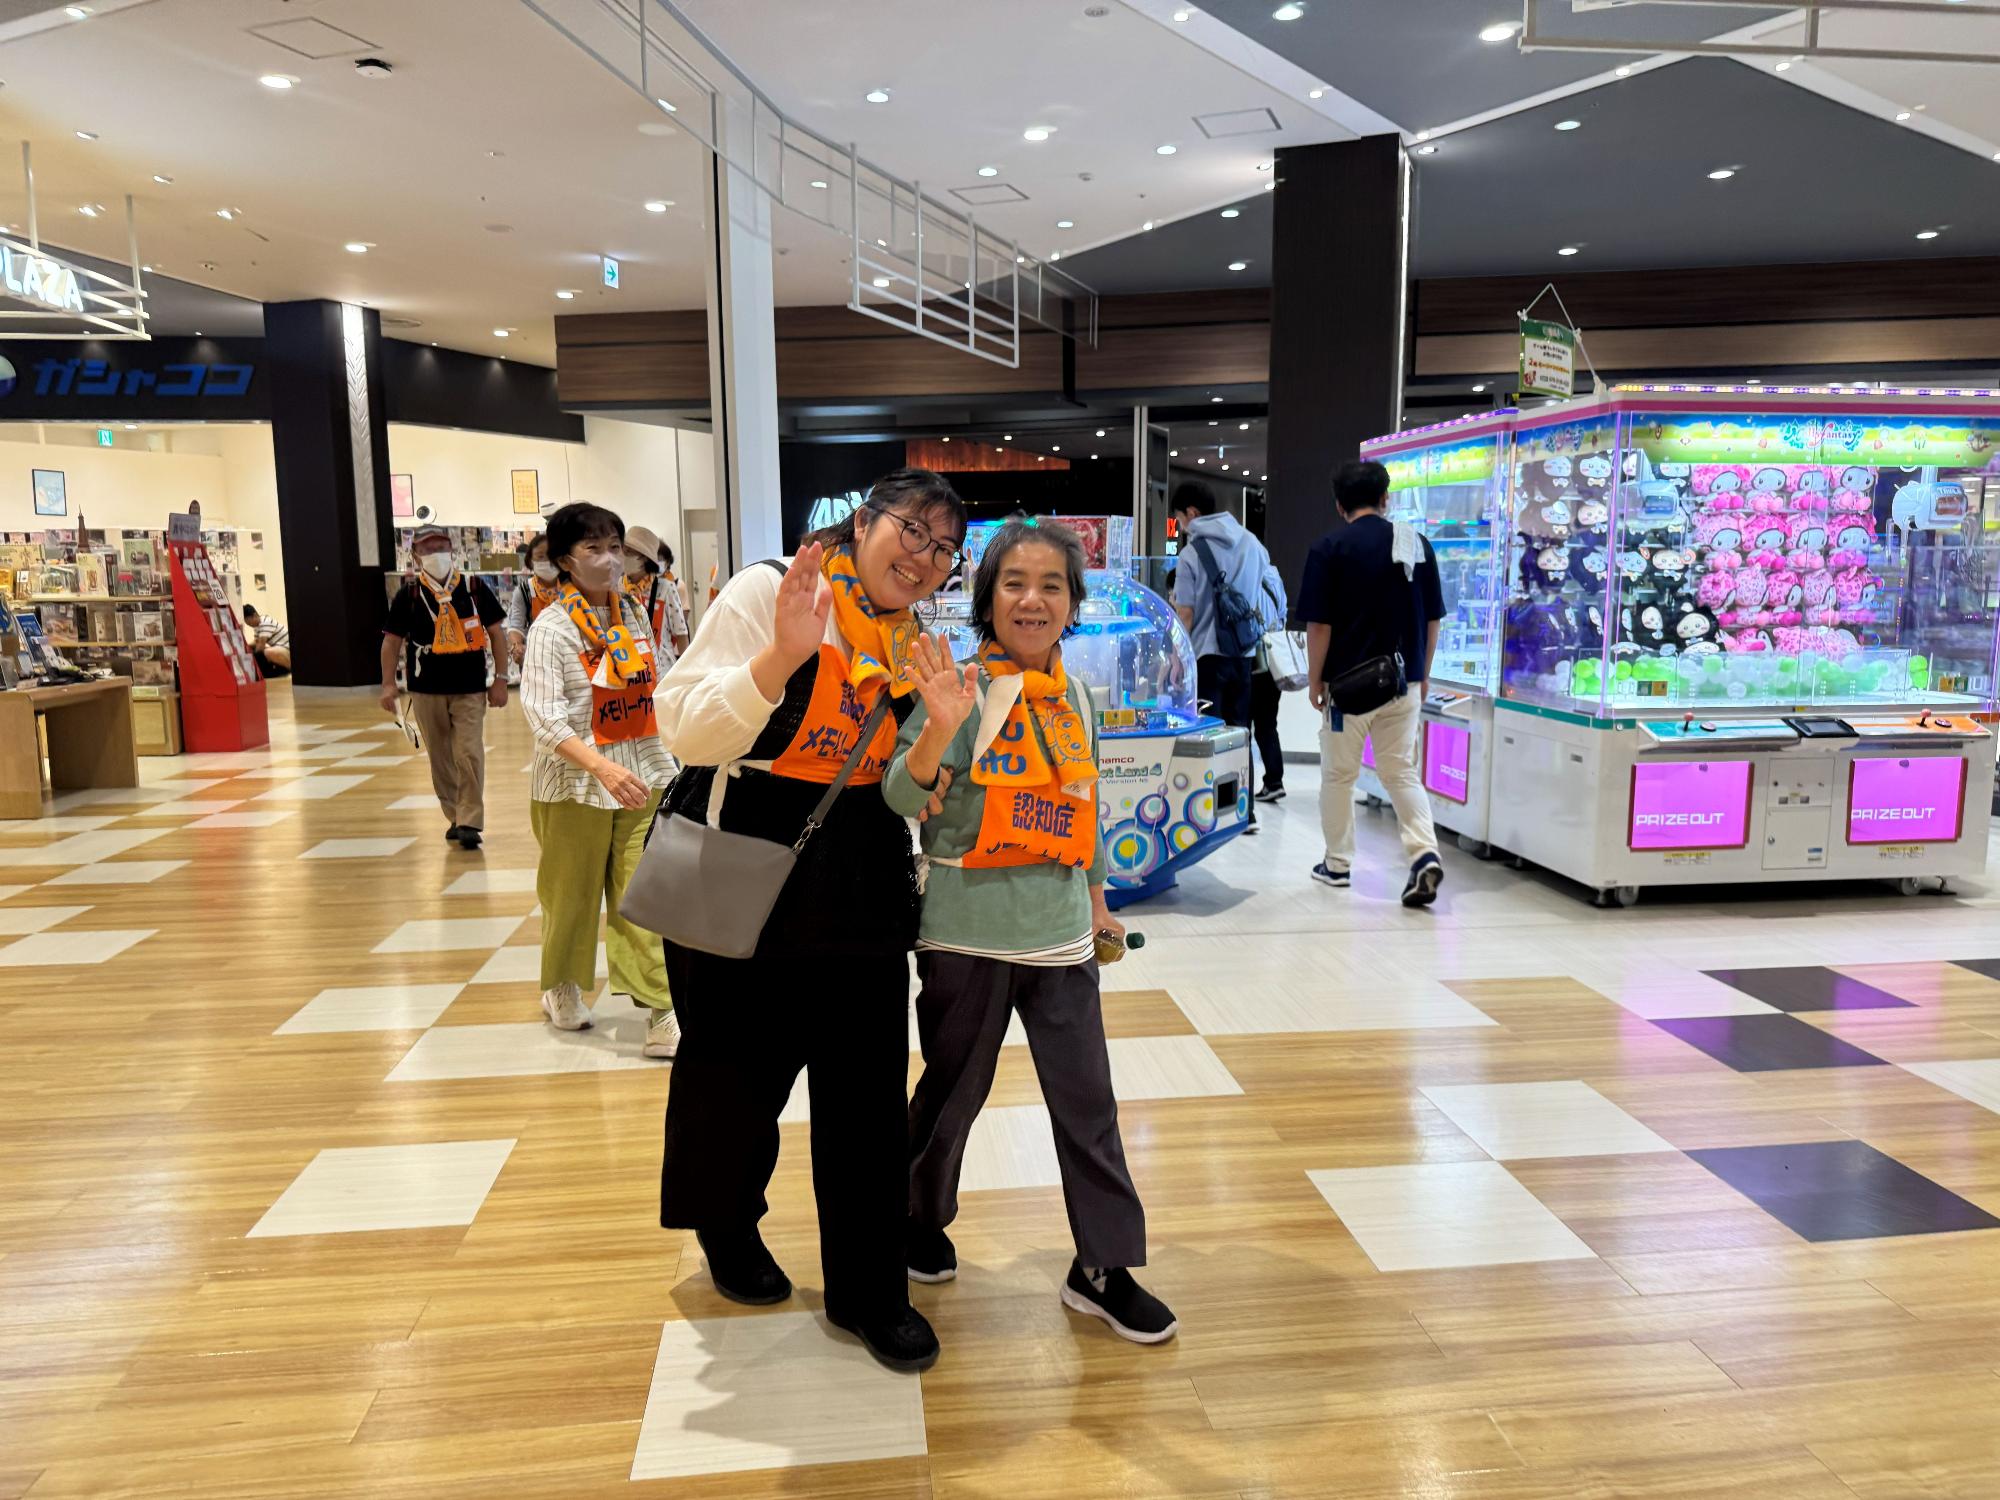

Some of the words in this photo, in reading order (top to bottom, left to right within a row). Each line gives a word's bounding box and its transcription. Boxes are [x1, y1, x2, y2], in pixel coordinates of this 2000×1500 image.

[0, 246, 84, 313] LAZA
[33, 357, 254, 396] ガシャココ
[1115, 765, 1149, 777] Land
[1150, 762, 1162, 776] 4
[1012, 791, 1076, 839] 認知症
[1636, 812, 1725, 826] PRIZEOUT
[1851, 807, 1936, 822] PRIZEOUT
